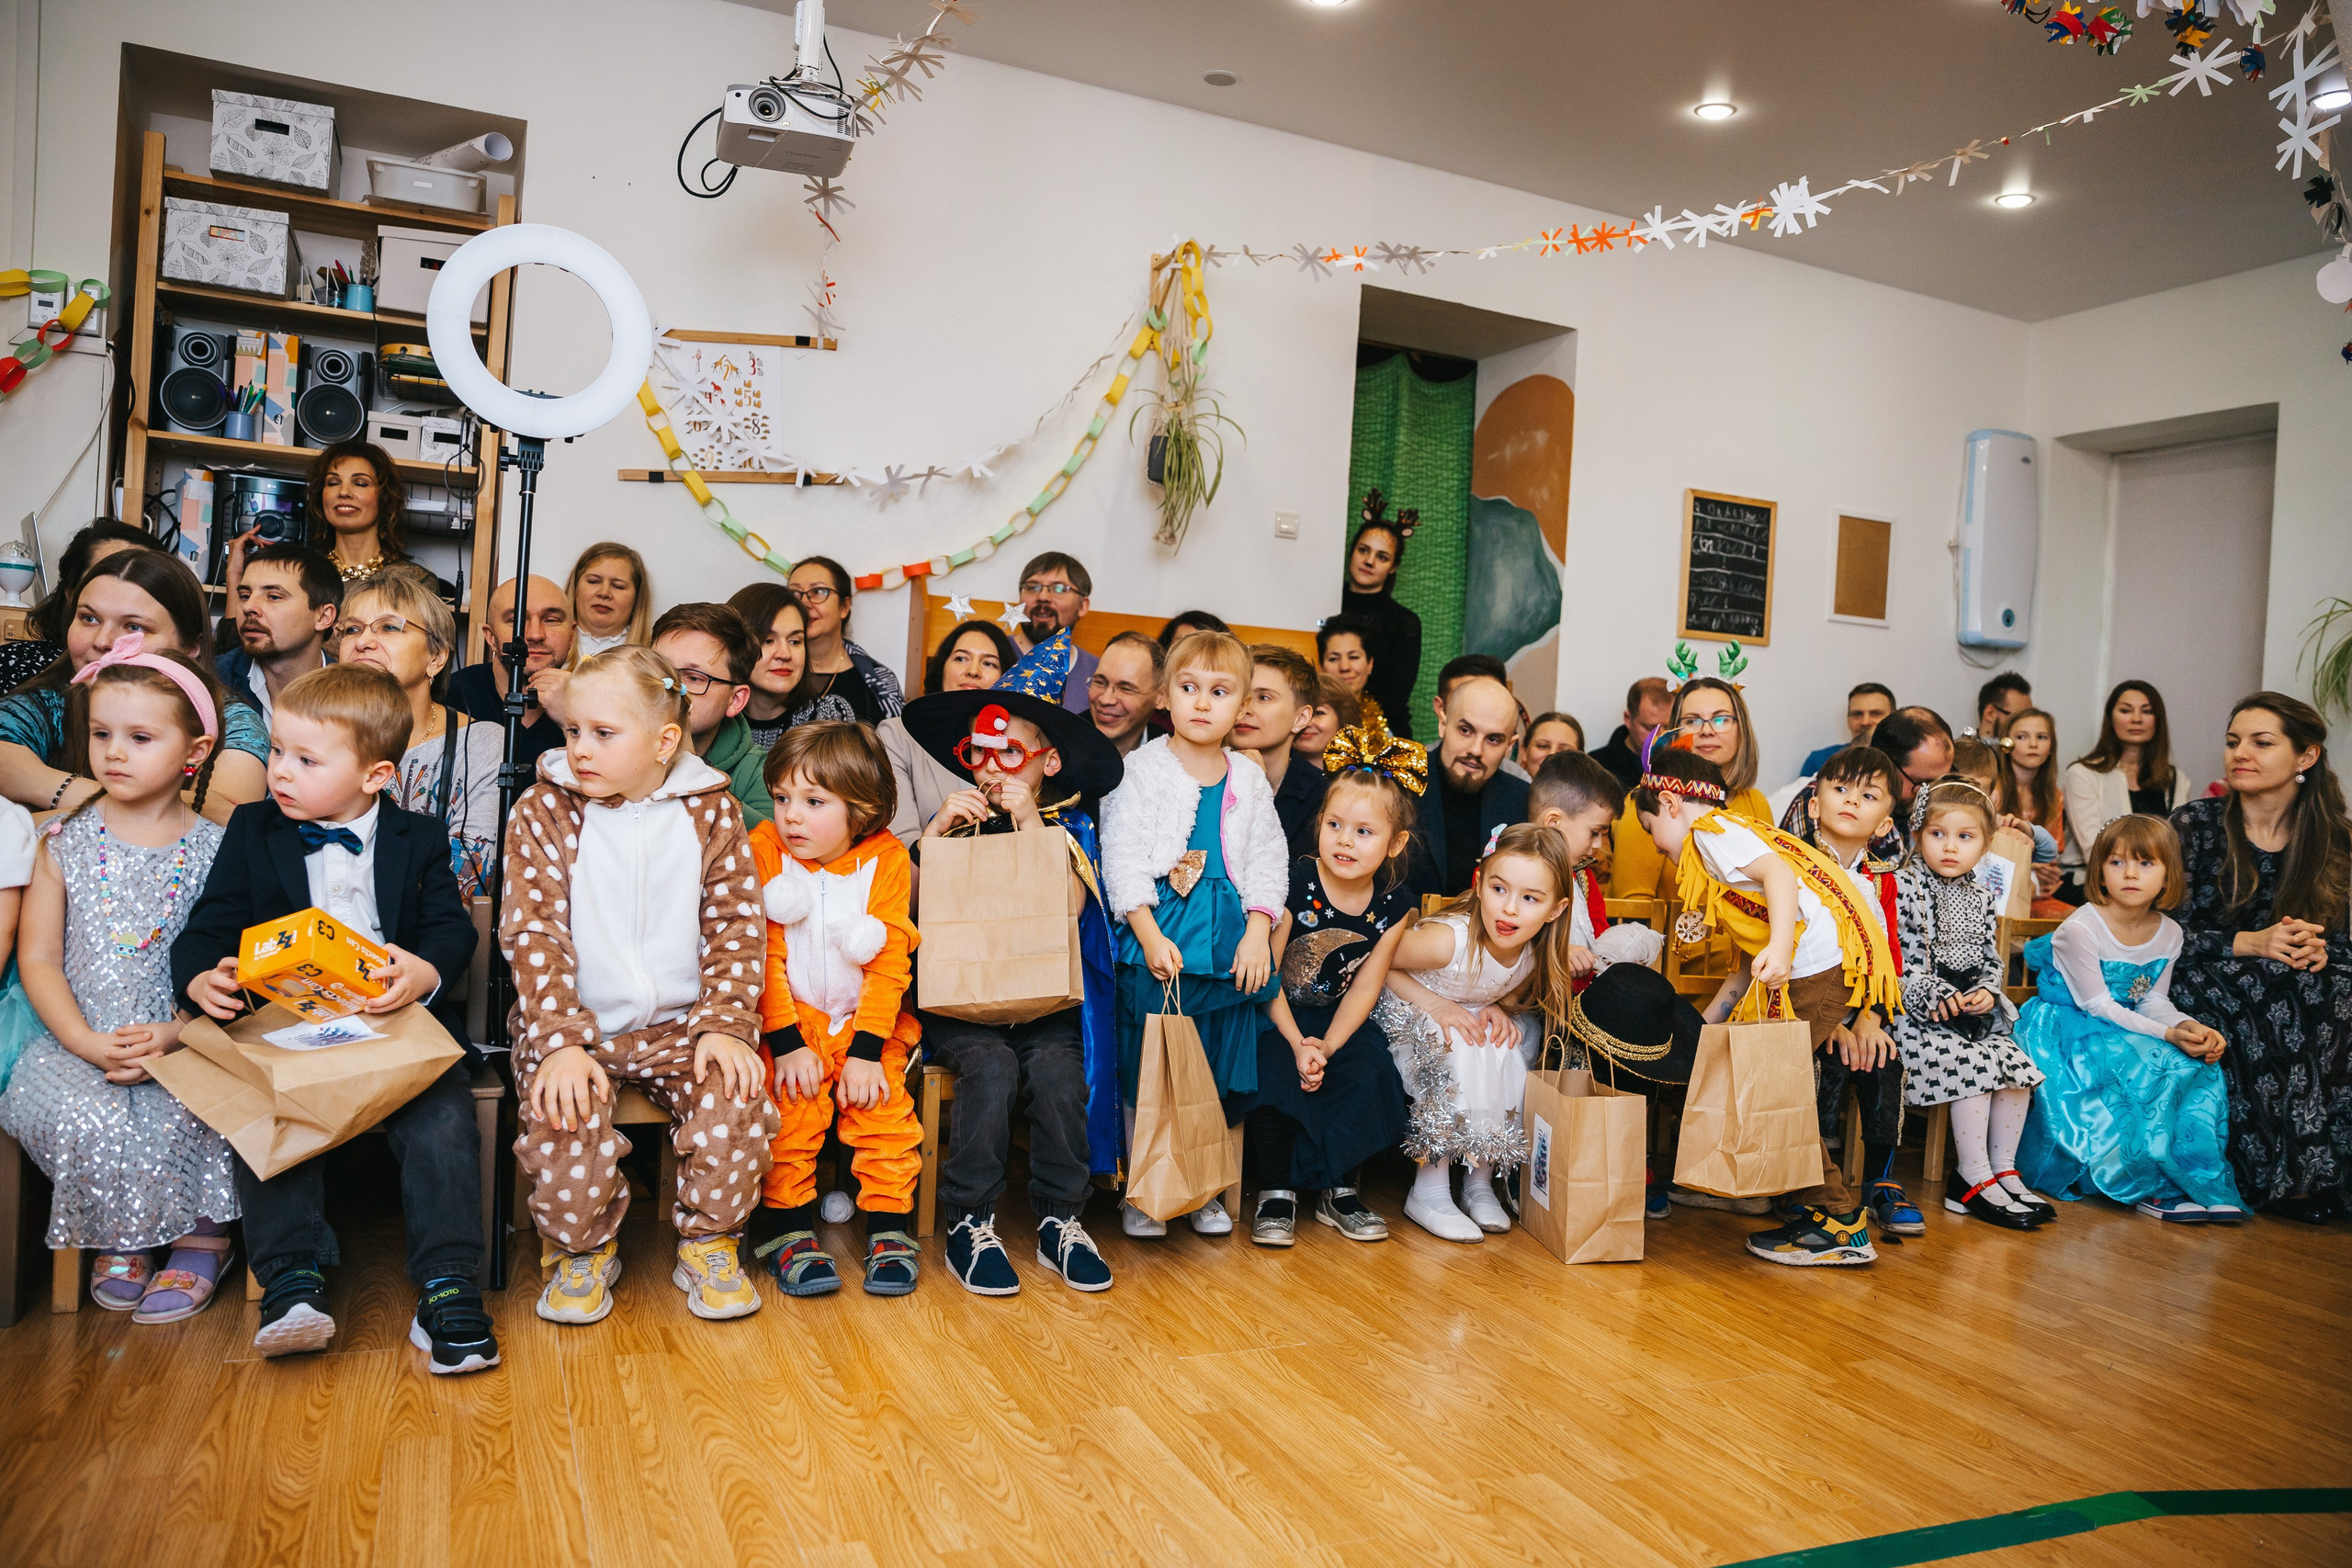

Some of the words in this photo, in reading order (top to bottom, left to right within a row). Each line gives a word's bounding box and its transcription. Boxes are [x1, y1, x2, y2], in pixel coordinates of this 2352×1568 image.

[723, 364, 730, 381] 2
[749, 357, 757, 376] 3
[743, 389, 752, 407] 5
[752, 418, 761, 434] 8
[705, 450, 715, 468] 9
[317, 919, 335, 941] C3
[345, 935, 361, 952] Can
[361, 946, 387, 966] Insects
[296, 963, 324, 977] C3
[301, 977, 323, 992] Can
[322, 989, 361, 1012] Insects
